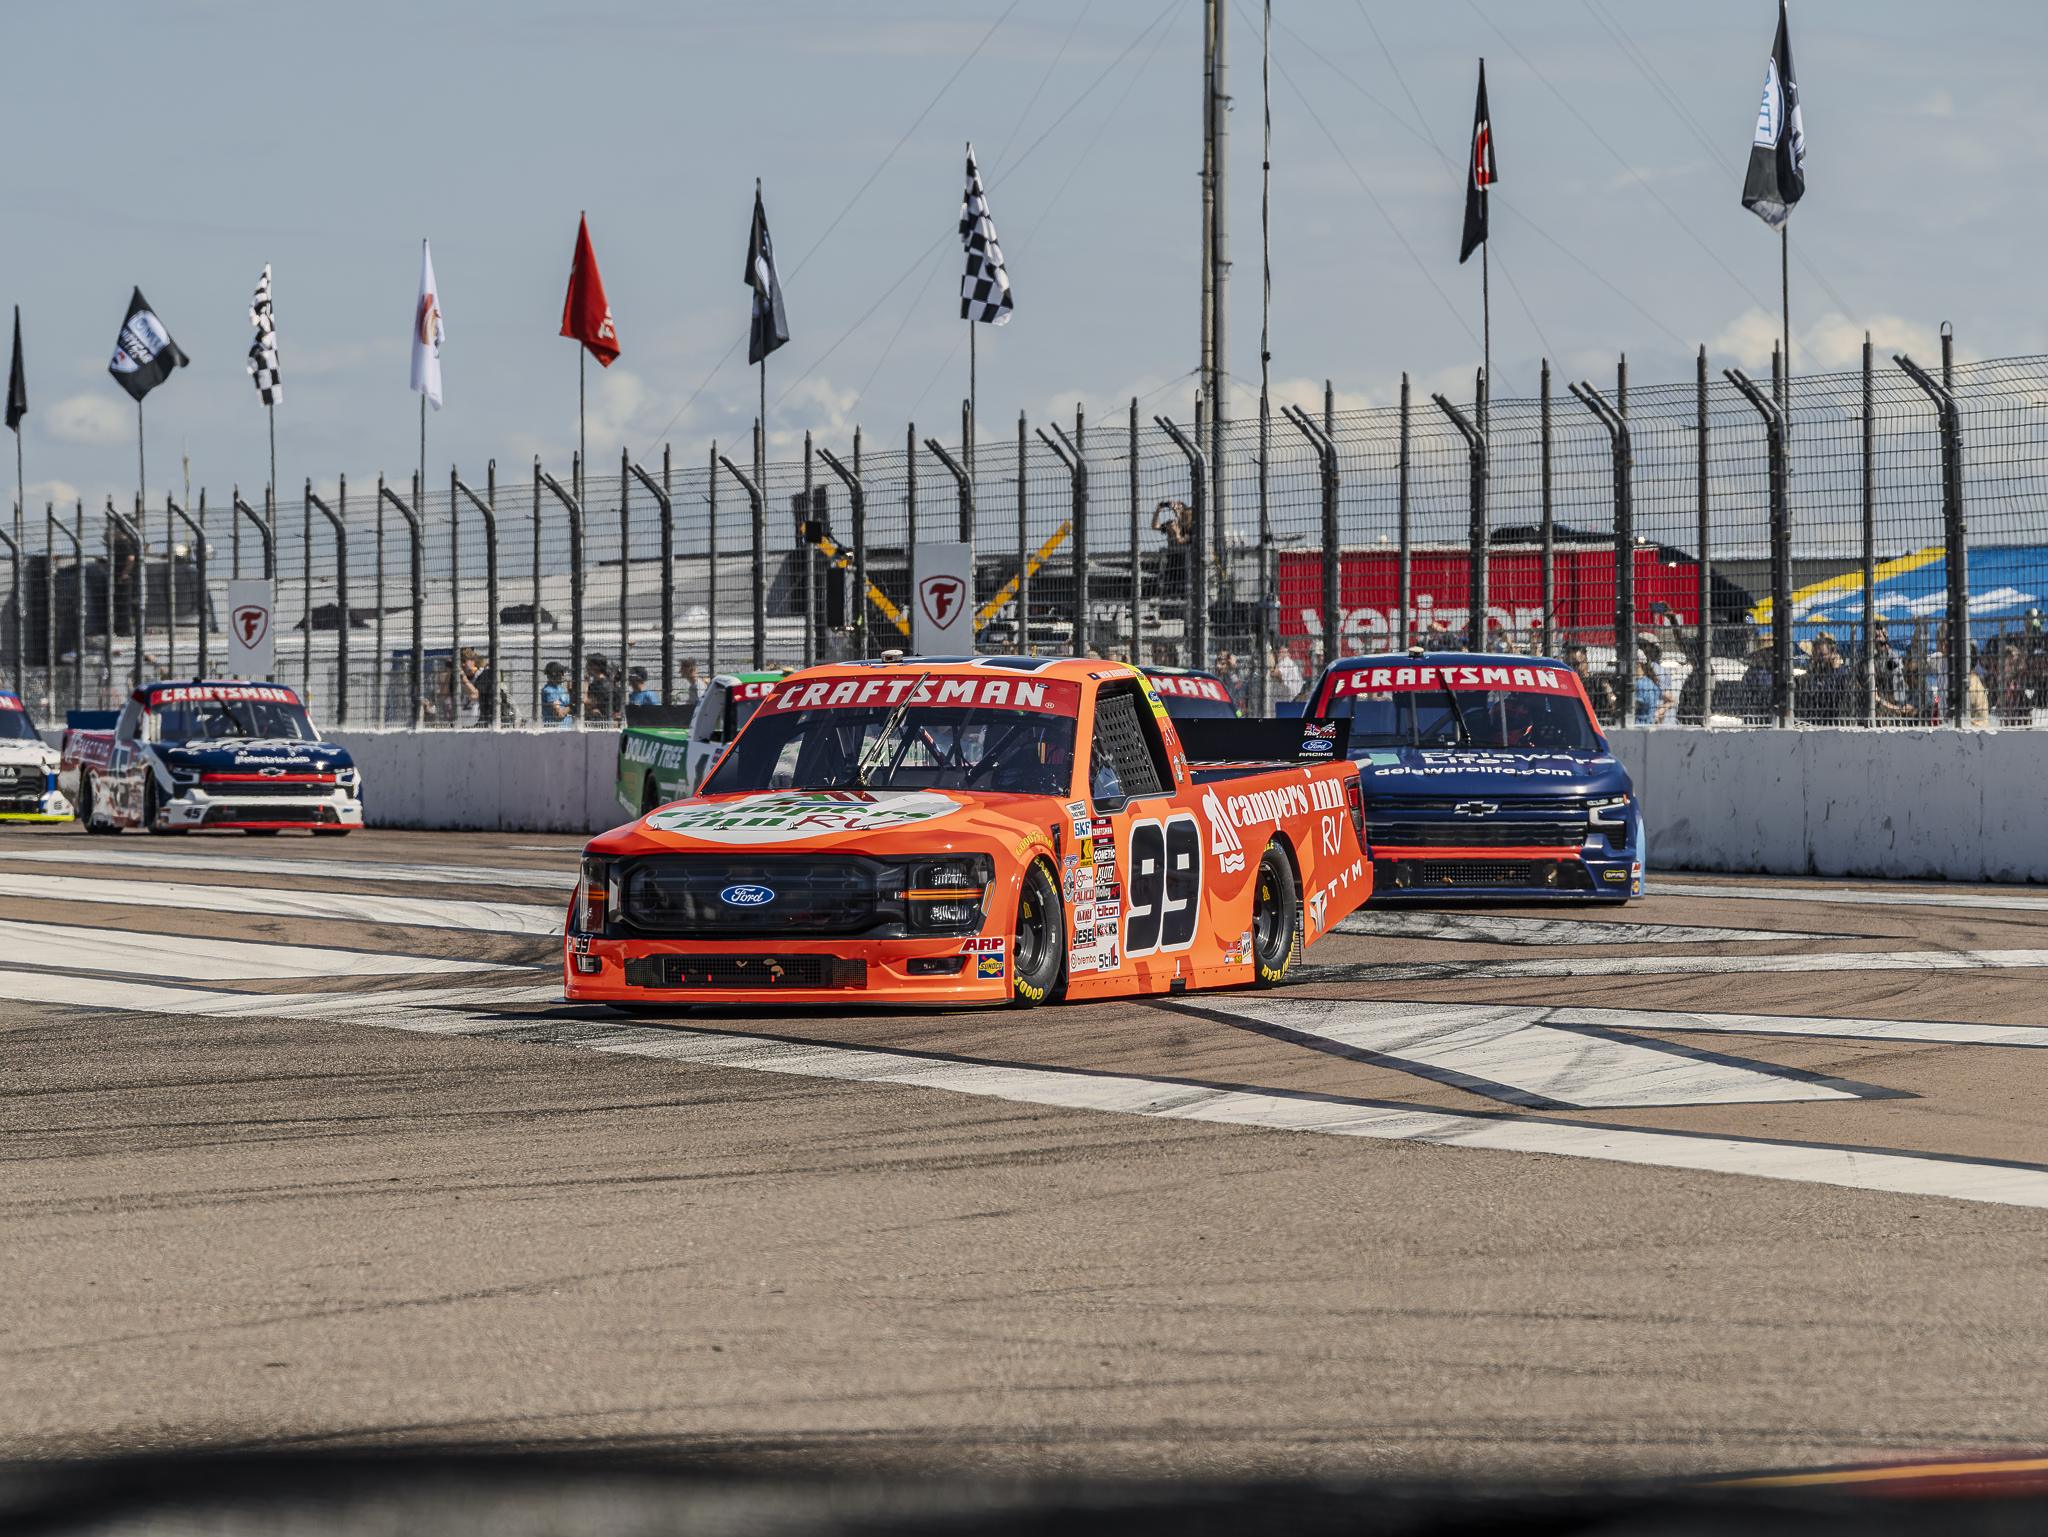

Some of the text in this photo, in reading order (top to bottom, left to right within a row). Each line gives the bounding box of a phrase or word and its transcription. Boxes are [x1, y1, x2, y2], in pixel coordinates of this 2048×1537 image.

[1351, 667, 1559, 689] CRAFTSMAN
[161, 687, 288, 702] CRAFTSMAN
[776, 680, 1044, 710] CRAFTSMAN
[624, 737, 685, 769] DOLLAR TREE
[1374, 766, 1572, 777] delawarelife.com
[1226, 768, 1345, 831] campers inn
[184, 807, 201, 820] 45
[1075, 821, 1091, 837] SKF
[1321, 811, 1345, 857] RV
[1124, 812, 1204, 959] 99
[1328, 858, 1363, 898] TYM
[1097, 905, 1119, 917] tilton
[962, 938, 1004, 951] ARP
[1073, 927, 1096, 945] JESEL
[979, 962, 1004, 970] SUNOCO
[1077, 954, 1097, 966] brembo
